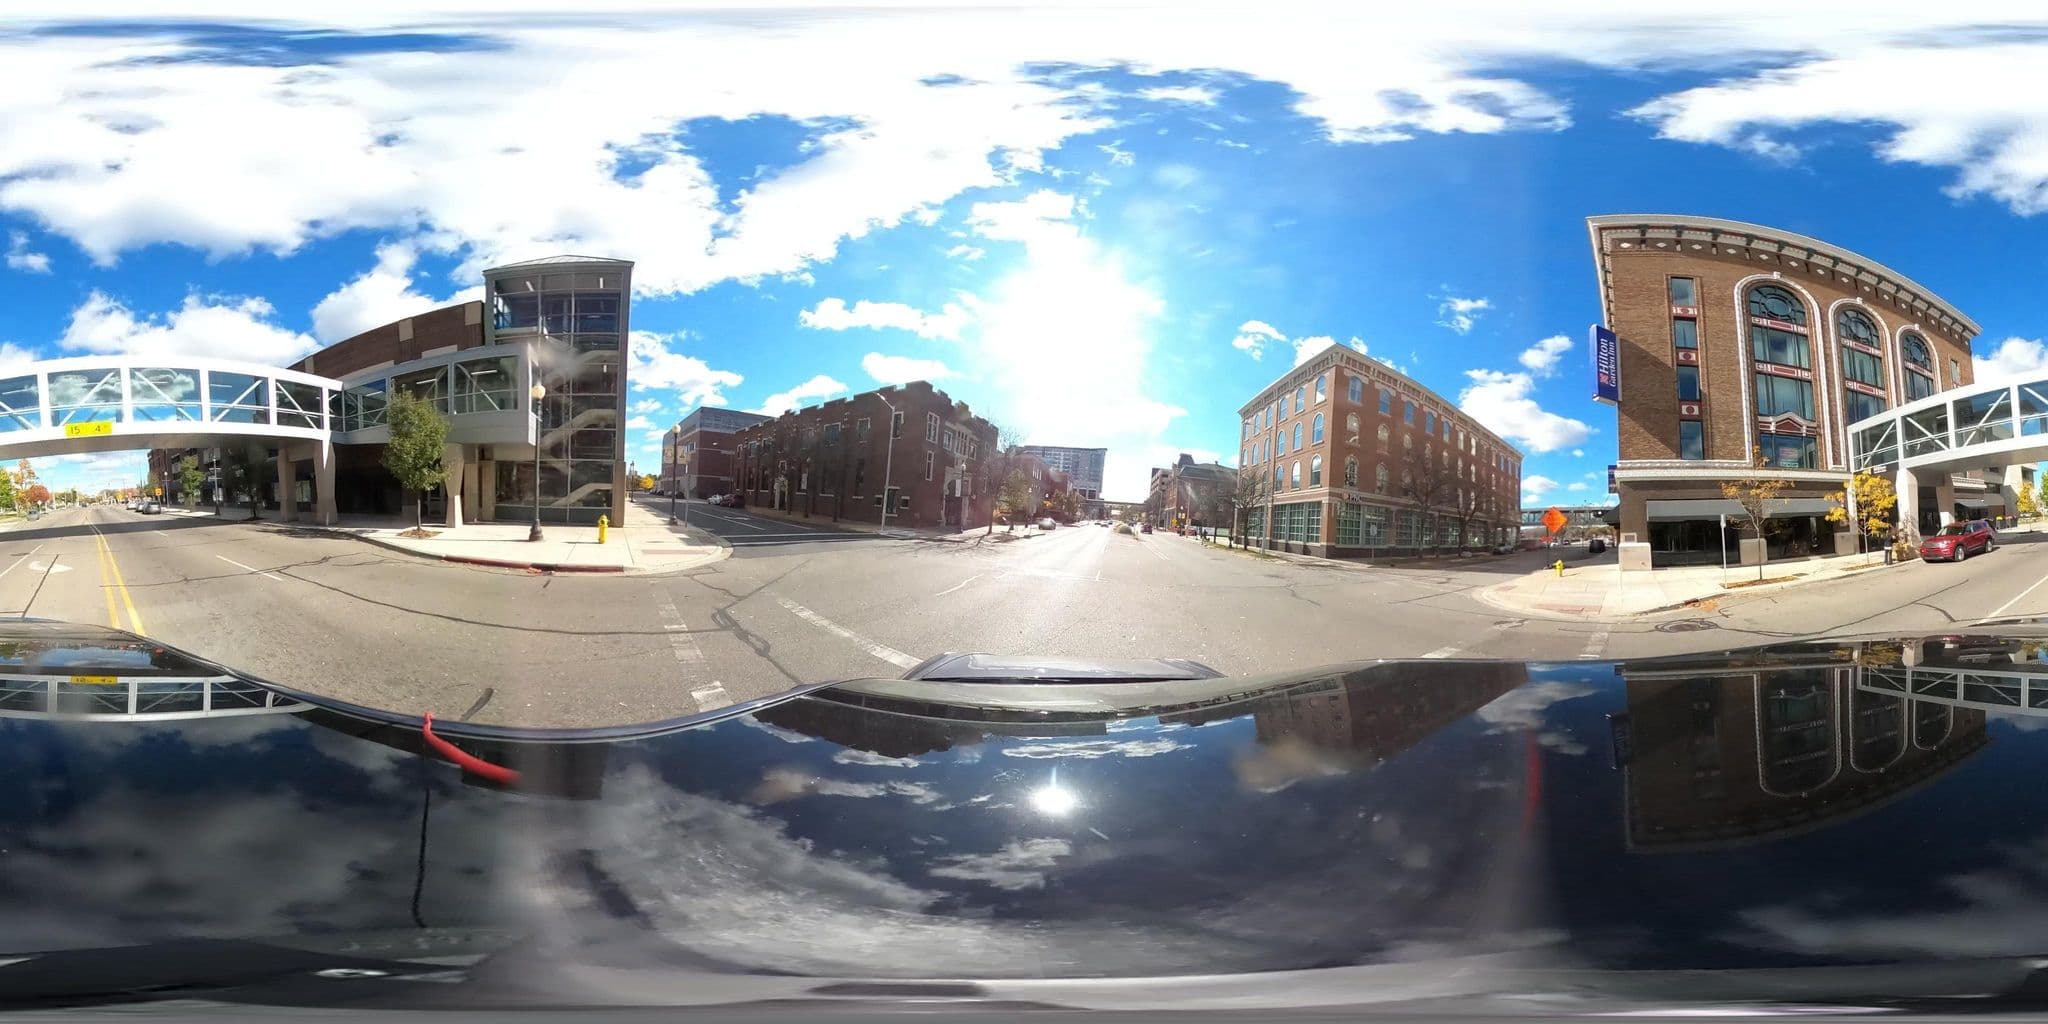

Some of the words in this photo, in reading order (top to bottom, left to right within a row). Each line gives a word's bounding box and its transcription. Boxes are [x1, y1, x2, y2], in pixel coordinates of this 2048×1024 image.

[1599, 338, 1609, 374] Hilton
[1608, 341, 1616, 356] Inn
[1608, 357, 1616, 387] Garden
